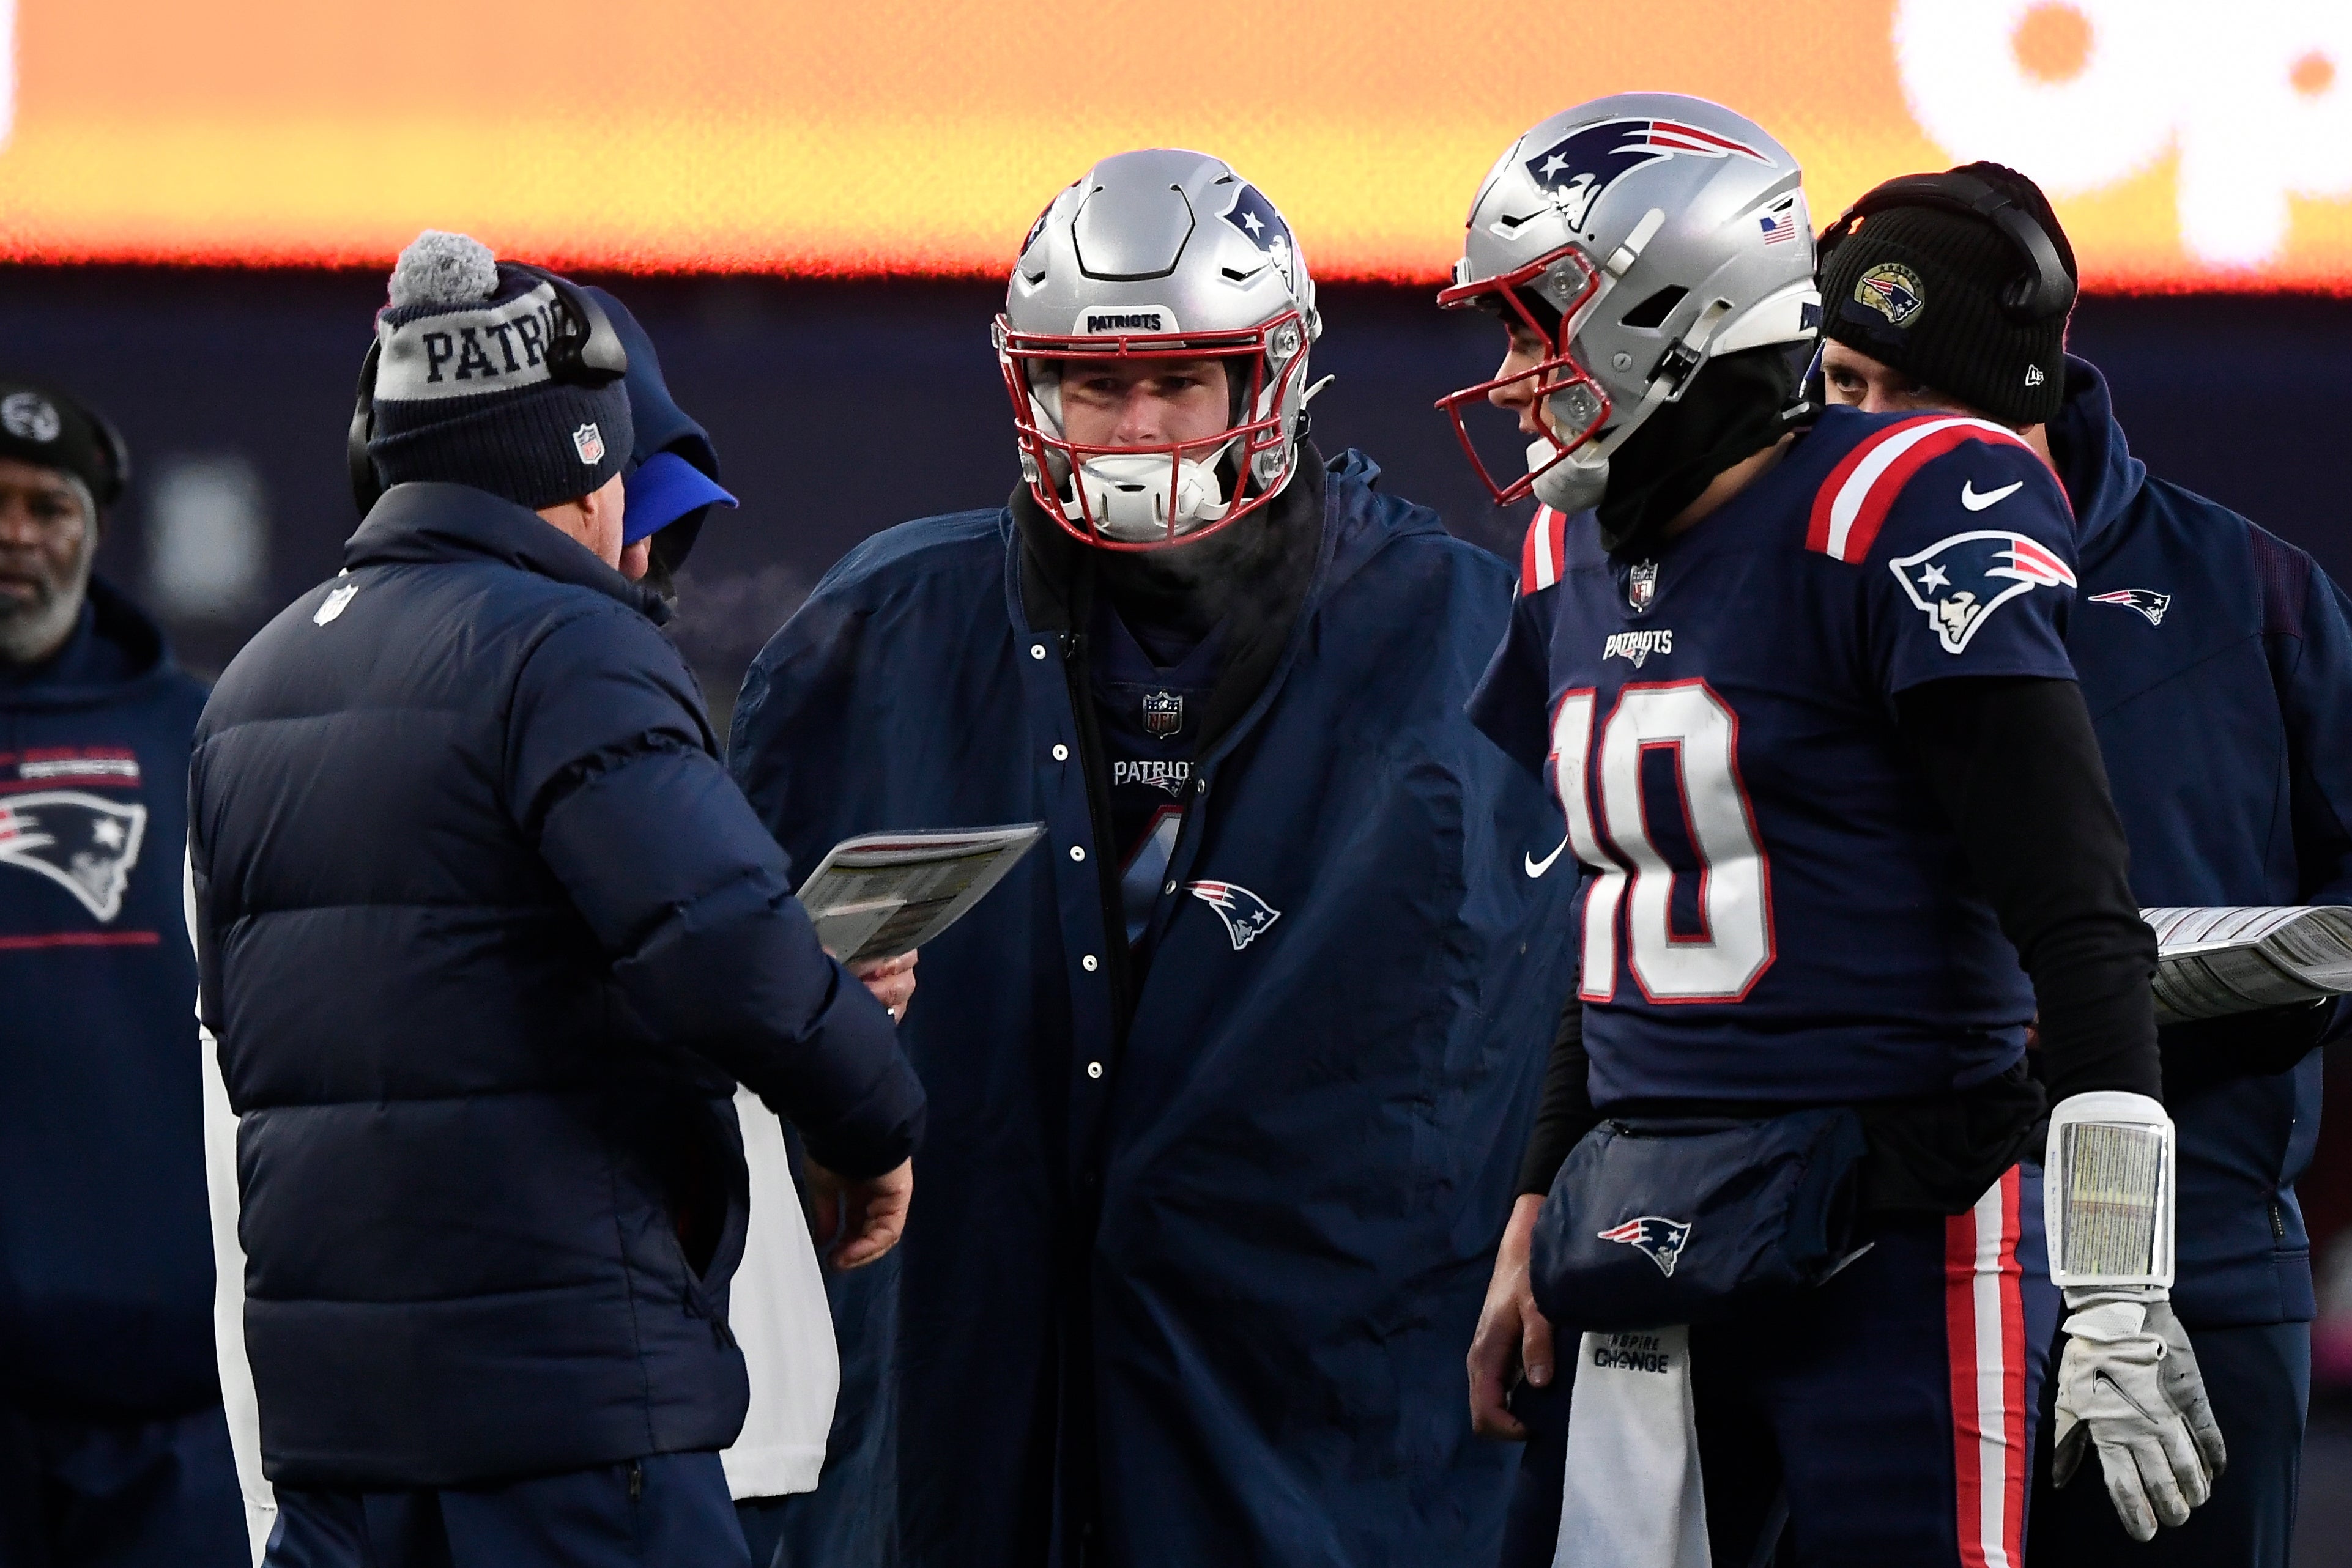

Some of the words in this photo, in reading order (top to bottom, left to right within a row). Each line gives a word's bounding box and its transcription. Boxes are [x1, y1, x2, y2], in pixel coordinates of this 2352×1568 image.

[1087, 313, 1161, 333] PATRIOTS
[1602, 629, 1673, 661] PATRIOTS
[1114, 761, 1194, 786] PATRIO
[1549, 677, 1776, 1004] 10
